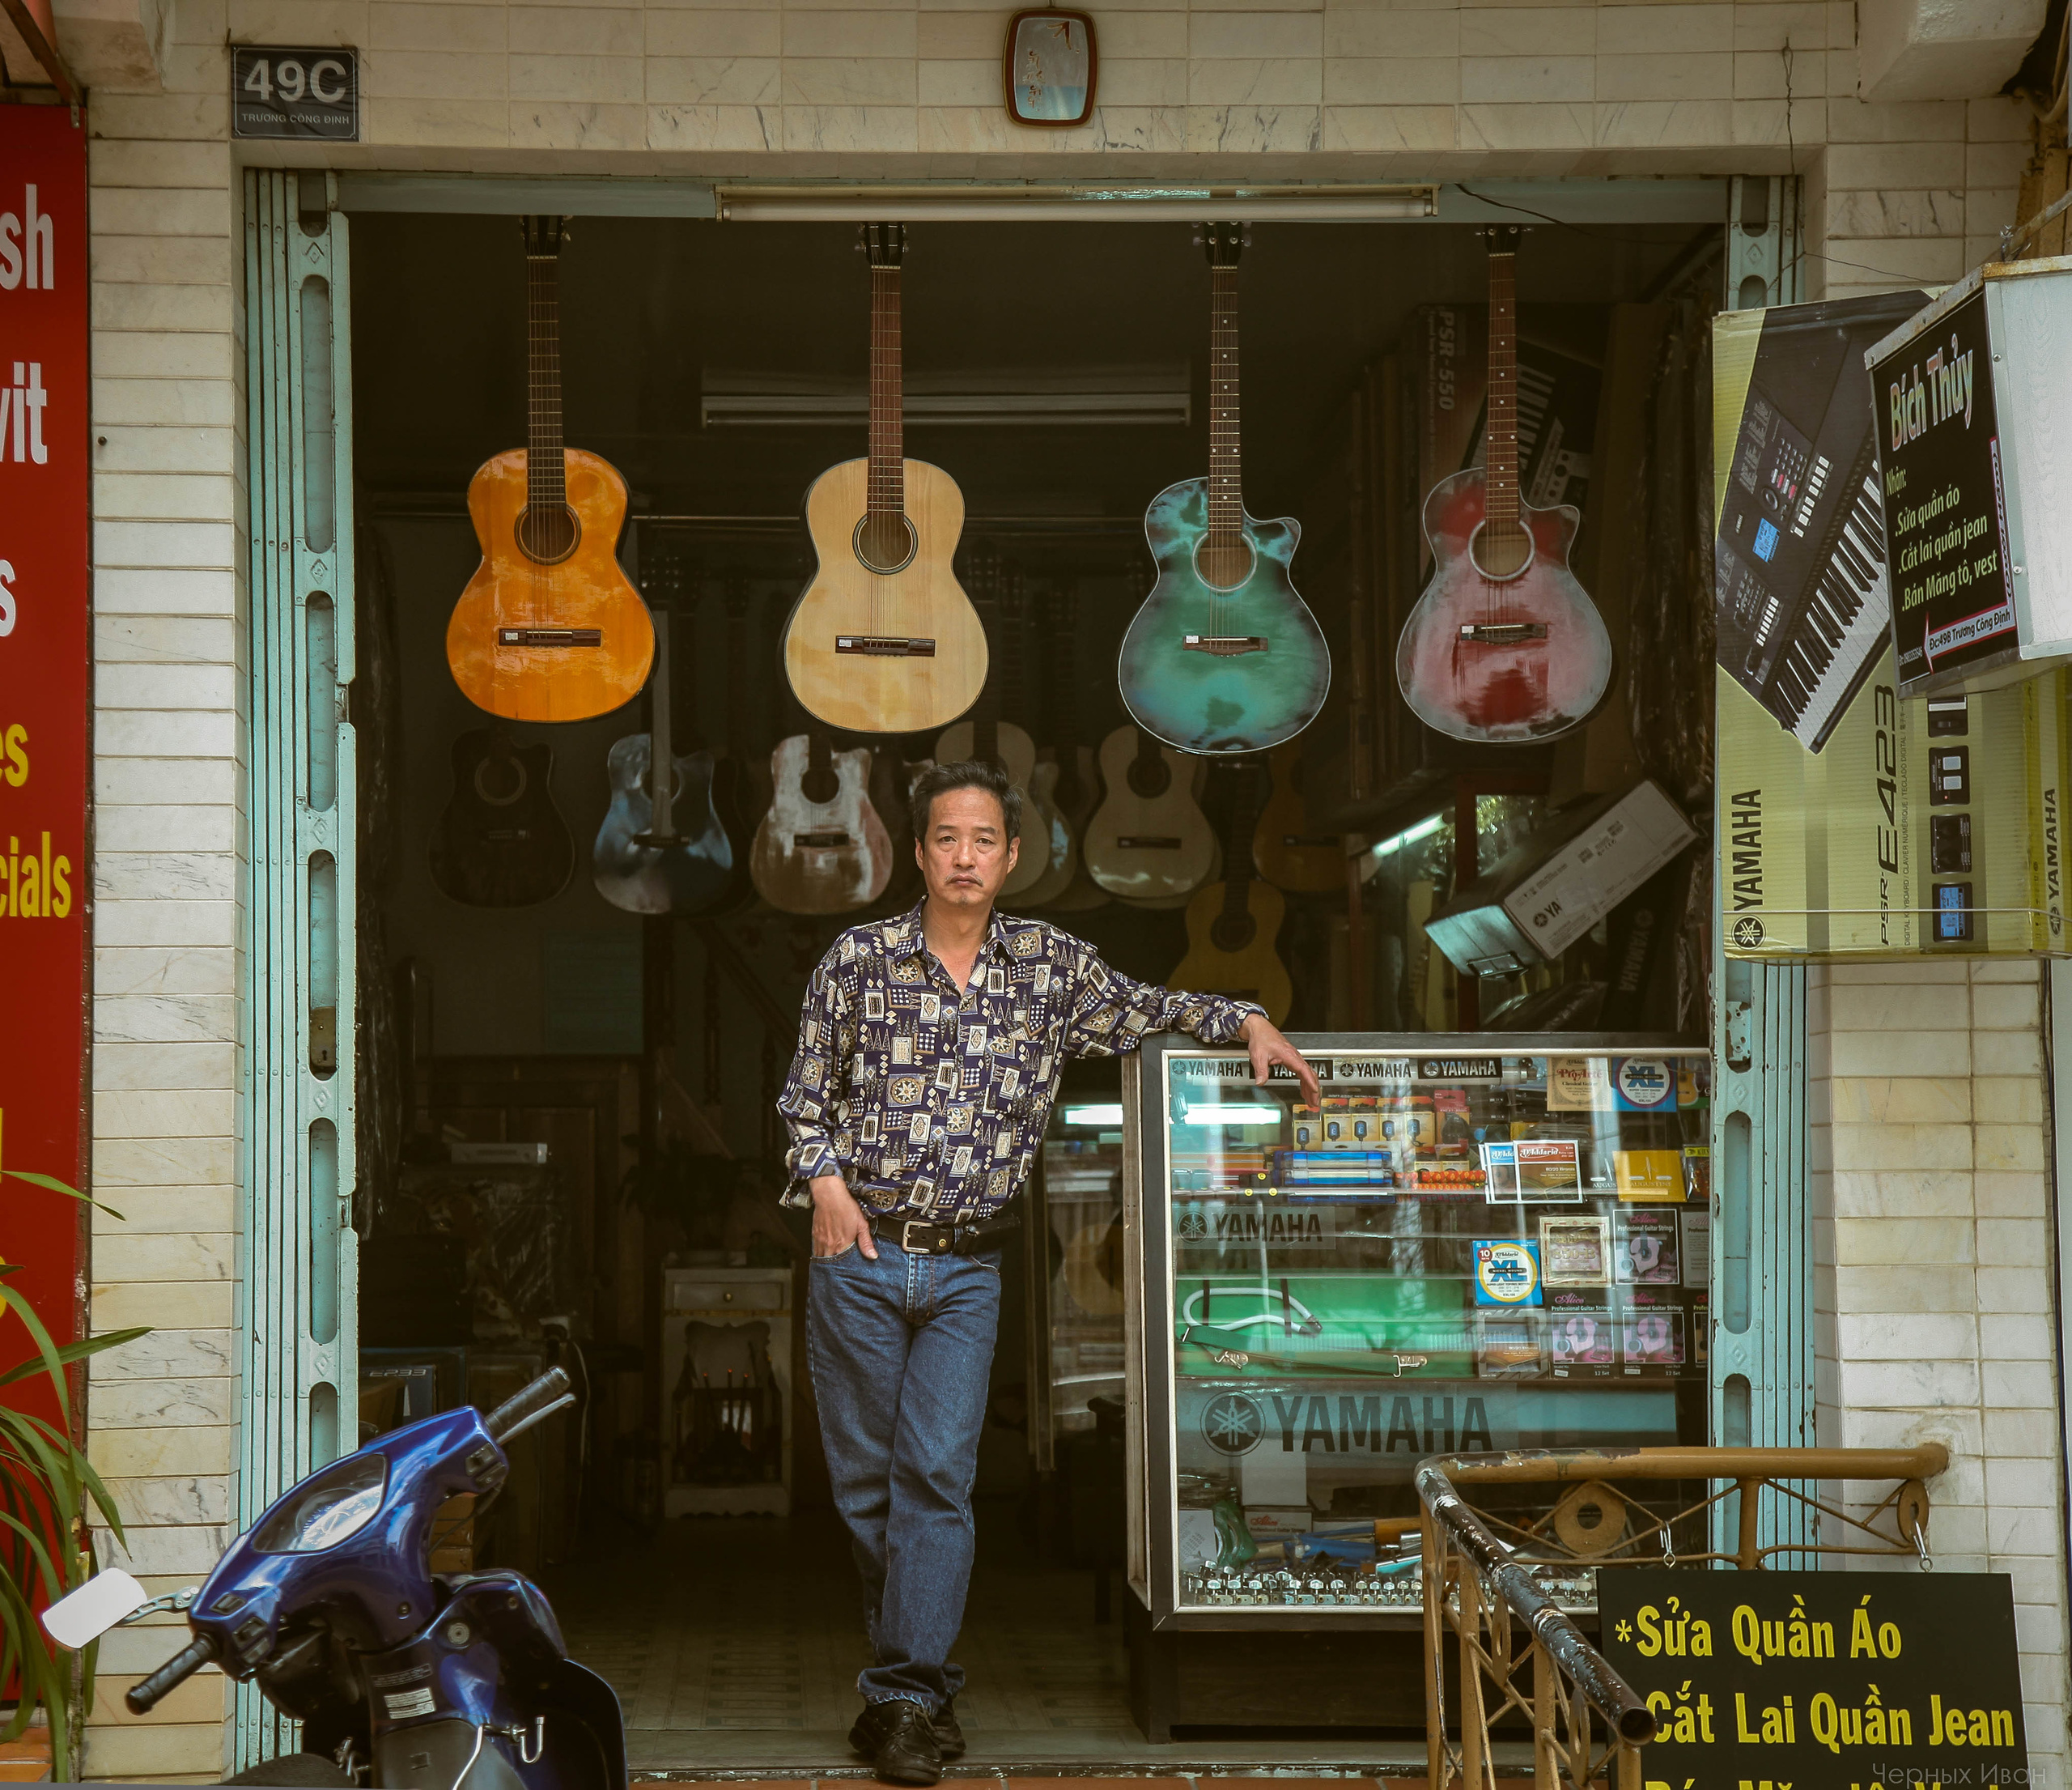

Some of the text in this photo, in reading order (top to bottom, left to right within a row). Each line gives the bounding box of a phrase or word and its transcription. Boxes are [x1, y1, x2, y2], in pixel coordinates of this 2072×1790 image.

[244, 59, 346, 104] 49C
[290, 113, 321, 123] CÔNG
[325, 116, 350, 125] ĐỊNH
[1891, 334, 1972, 452] Bích Thủy
[1918, 489, 1944, 529] quần
[1946, 483, 1960, 509] áo
[1920, 535, 1933, 563] lai
[1934, 521, 1961, 560] quần
[1963, 515, 1988, 550] jean
[1926, 572, 1956, 601] Măng
[1958, 559, 1973, 586] tô,
[1974, 550, 1998, 579] vest
[1976, 619, 1993, 631] Công
[1993, 609, 2011, 627] Định
[1875, 685, 1899, 946] PSR-E423
[1731, 789, 1763, 912] YAMAHA
[2044, 789, 2060, 900] YAMAHA
[1619, 929, 1650, 992] YAMAHA
[1188, 1061, 1243, 1077] YAMAHA
[1273, 1063, 1327, 1078] YAHA
[1357, 1062, 1412, 1078] YAMAHA
[1439, 1061, 1497, 1076] YAMAHA
[1627, 1065, 1664, 1088] XL
[1213, 1214, 1323, 1242] YAMAHA
[1629, 1212, 1658, 1224] Alice
[1658, 1225, 1674, 1233] Strings
[1490, 1260, 1527, 1282] XL
[1555, 1293, 1585, 1304] Alice
[1625, 1293, 1655, 1304] Alice
[1272, 1396, 1493, 1453] YAMAHA
[1732, 1594, 1836, 1665] Quần
[1850, 1595, 1903, 1659] Áo
[1646, 1680, 2015, 1754] Cắt Lai Quần Jean
